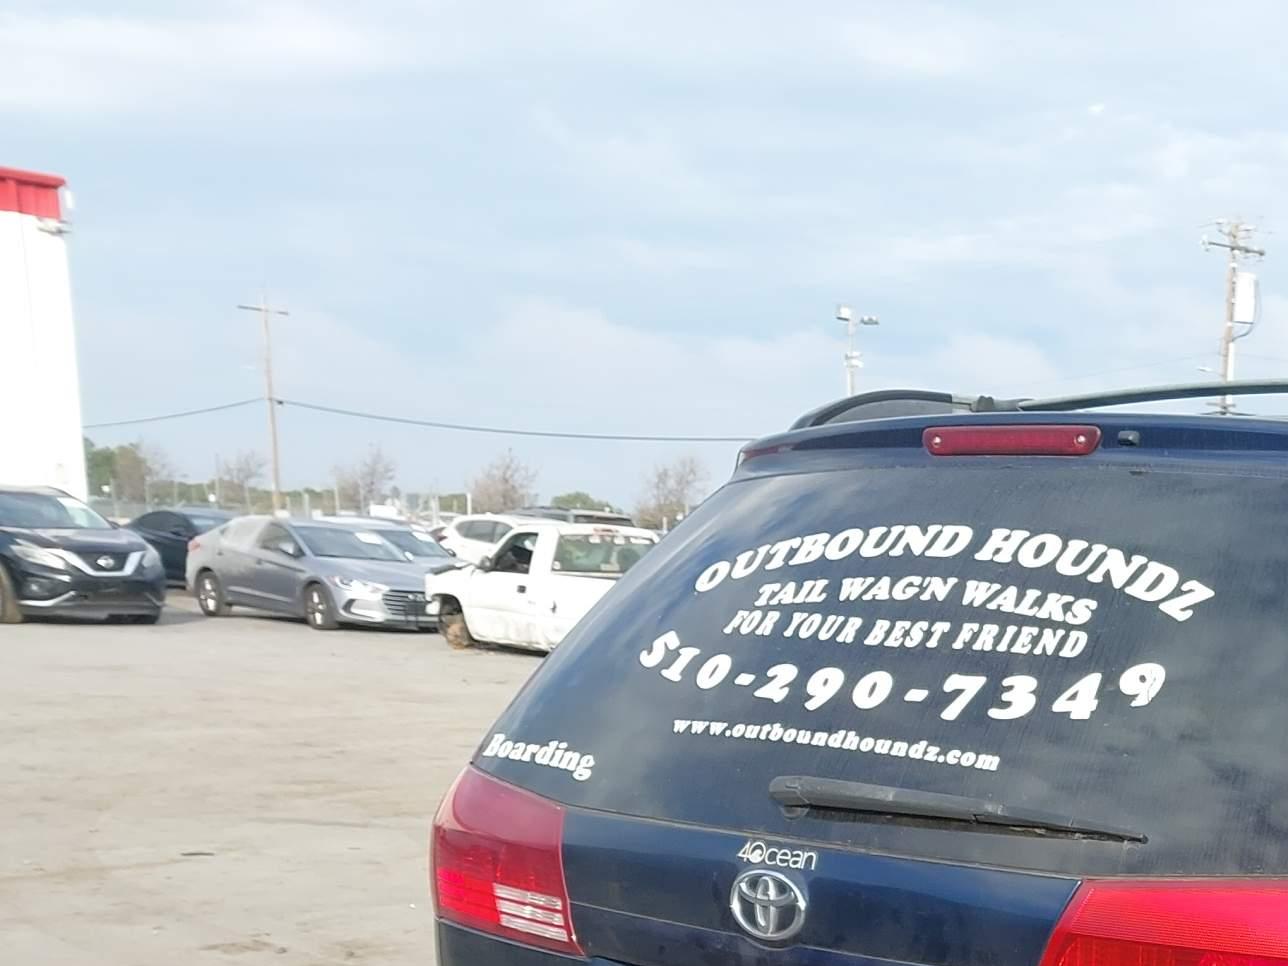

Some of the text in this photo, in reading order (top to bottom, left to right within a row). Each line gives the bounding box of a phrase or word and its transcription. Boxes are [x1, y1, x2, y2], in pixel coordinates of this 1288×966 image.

[695, 524, 1215, 622] OUTBOUND HOUNDZ
[753, 575, 1098, 625] TAIL WAG'N WALKS
[723, 609, 1089, 658] FOR YOUR BEST FRIEND
[639, 630, 1167, 721] 510-290-7349
[482, 733, 595, 781] Boarding
[672, 718, 1001, 771] www.outboundhoundz.com
